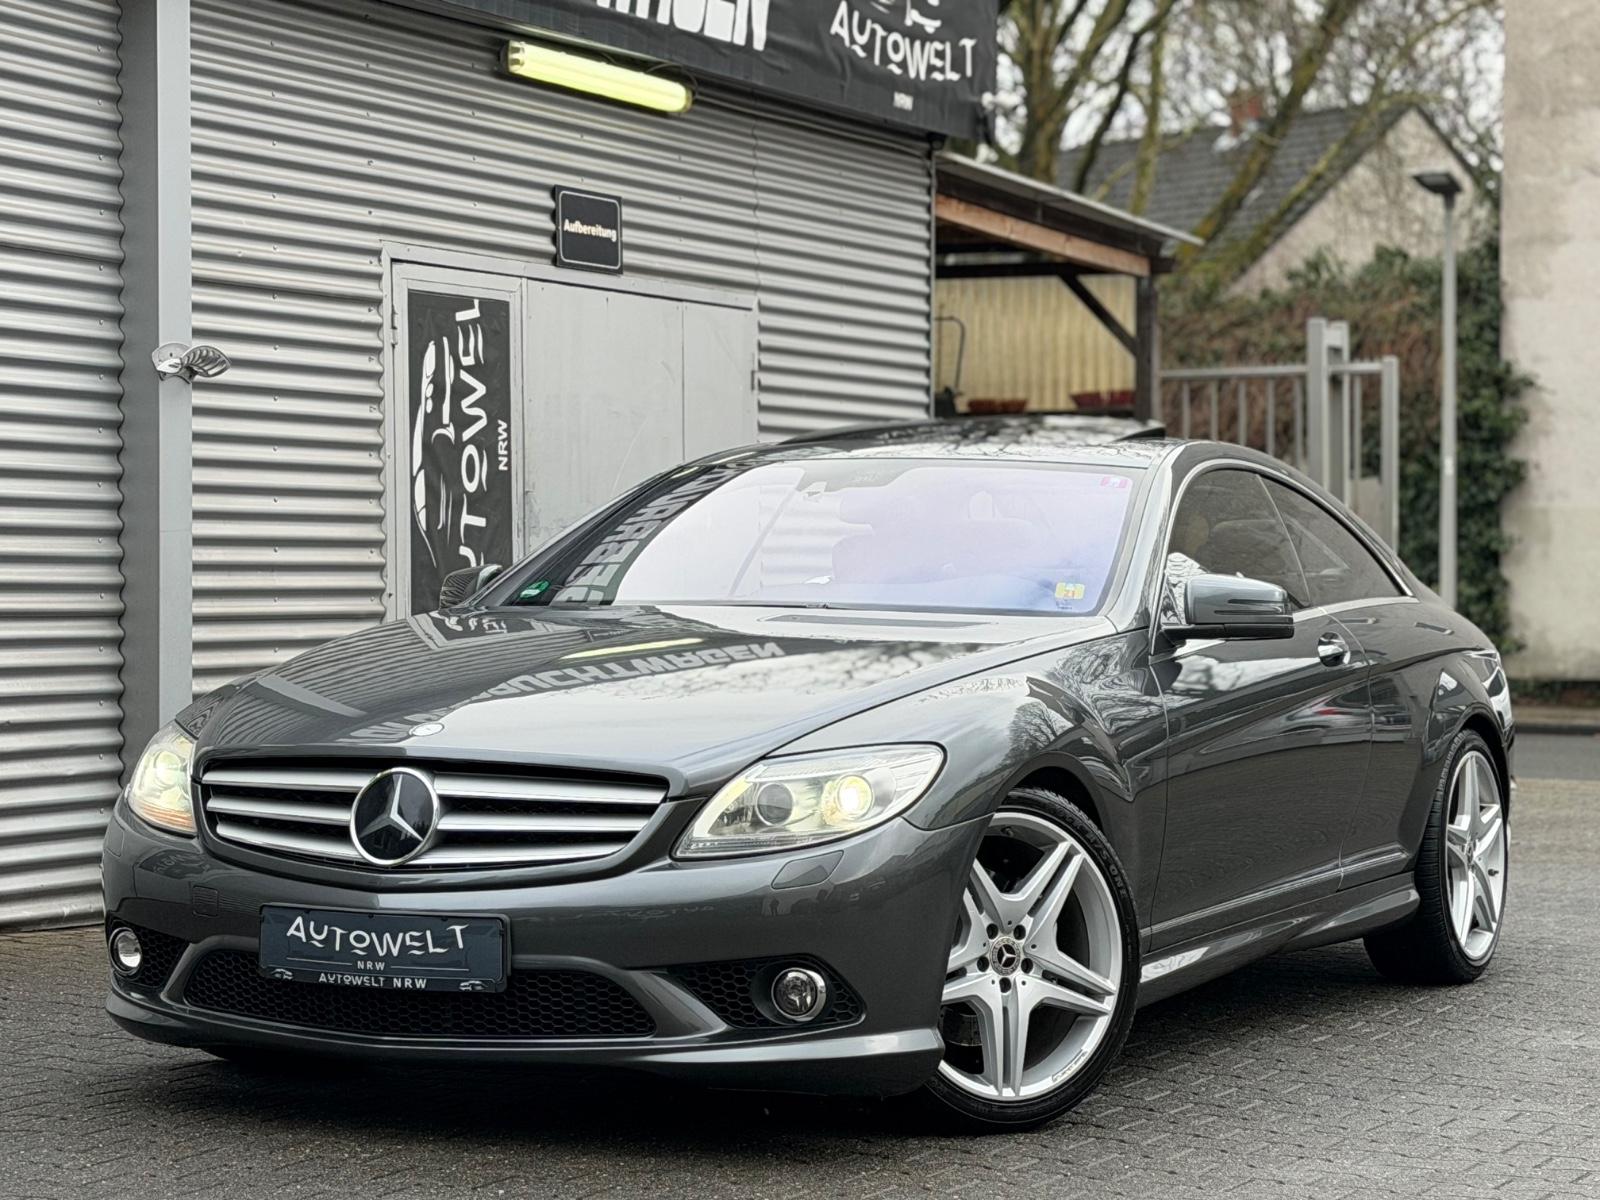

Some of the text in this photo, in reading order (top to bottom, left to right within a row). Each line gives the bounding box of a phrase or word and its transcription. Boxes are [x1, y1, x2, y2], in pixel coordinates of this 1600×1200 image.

[829, 0, 977, 82] AUTOWELT
[563, 218, 617, 243] Aufbereitung
[498, 420, 509, 471] NRW
[286, 916, 469, 957] AUTOWELT
[319, 972, 427, 989] AUTOWELT NRW
[357, 960, 385, 971] NRW
